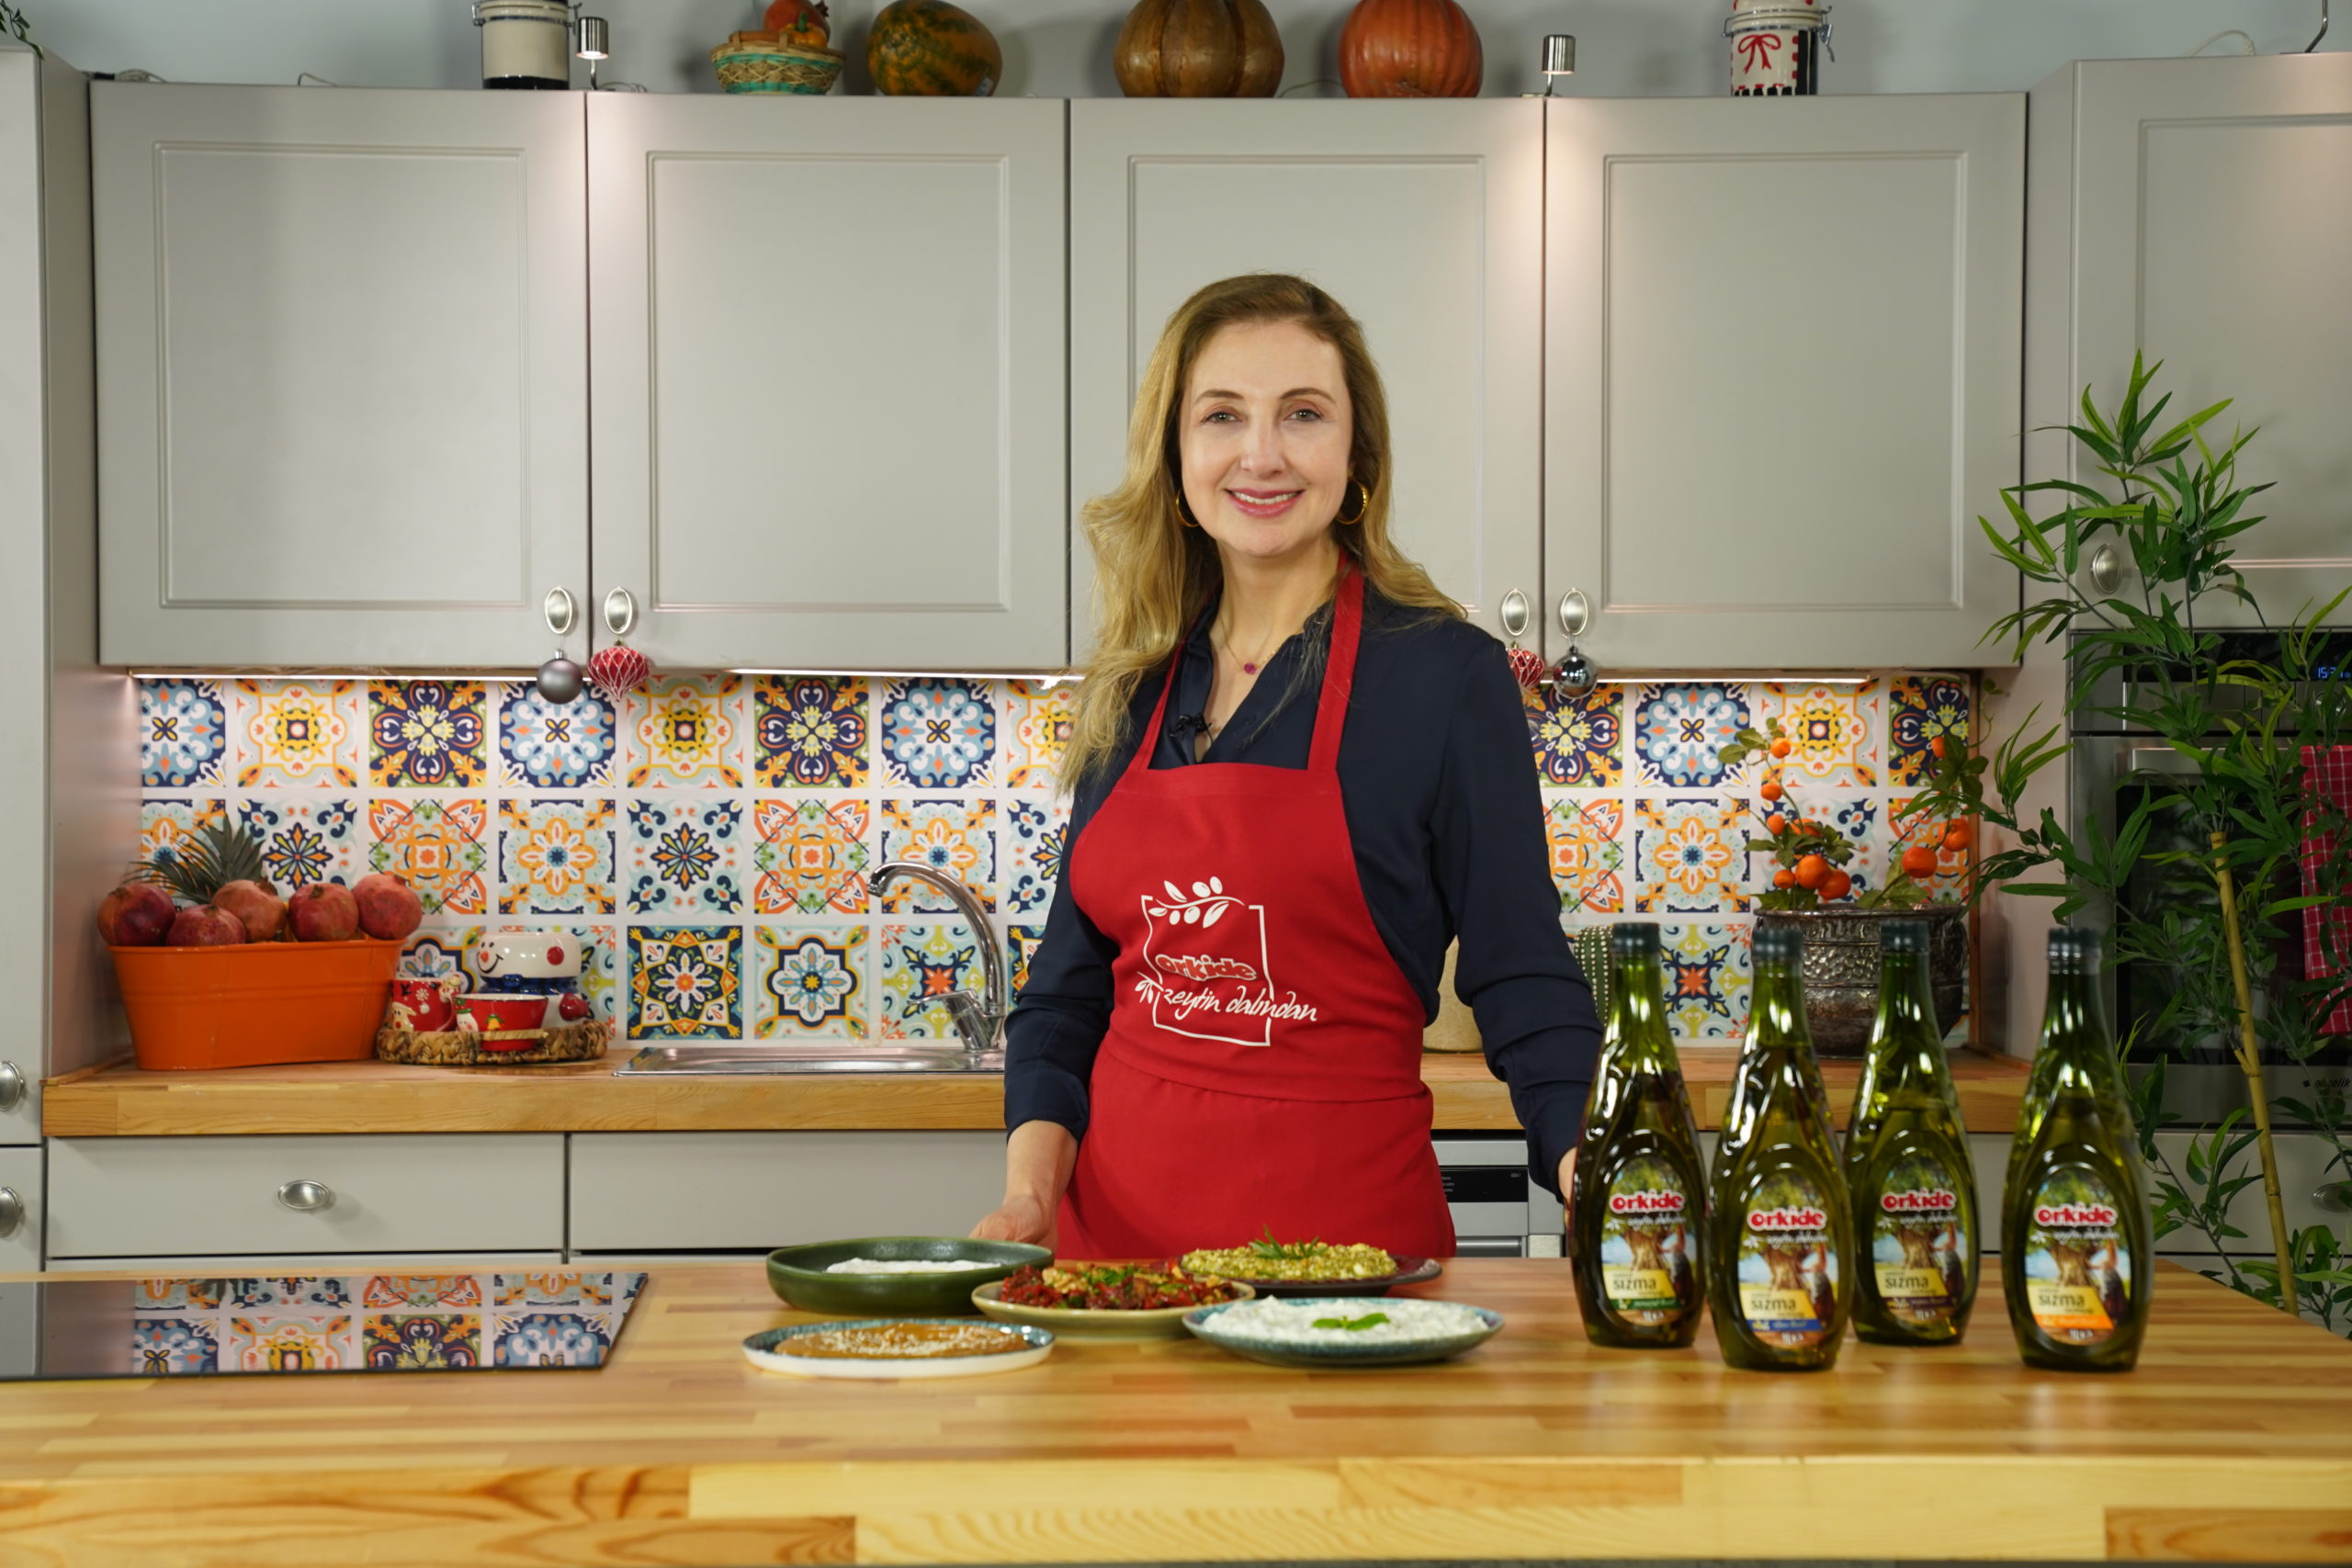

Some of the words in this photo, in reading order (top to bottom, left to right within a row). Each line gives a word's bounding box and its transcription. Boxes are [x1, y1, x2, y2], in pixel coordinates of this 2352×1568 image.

[1156, 953, 1258, 981] orkide
[1163, 987, 1221, 1020] zeytin
[1226, 985, 1317, 1021] dalından
[1609, 1188, 1685, 1213] orkide
[1881, 1187, 1956, 1213] orkide
[1747, 1204, 1827, 1232] orkide
[2034, 1201, 2119, 1227] orkide
